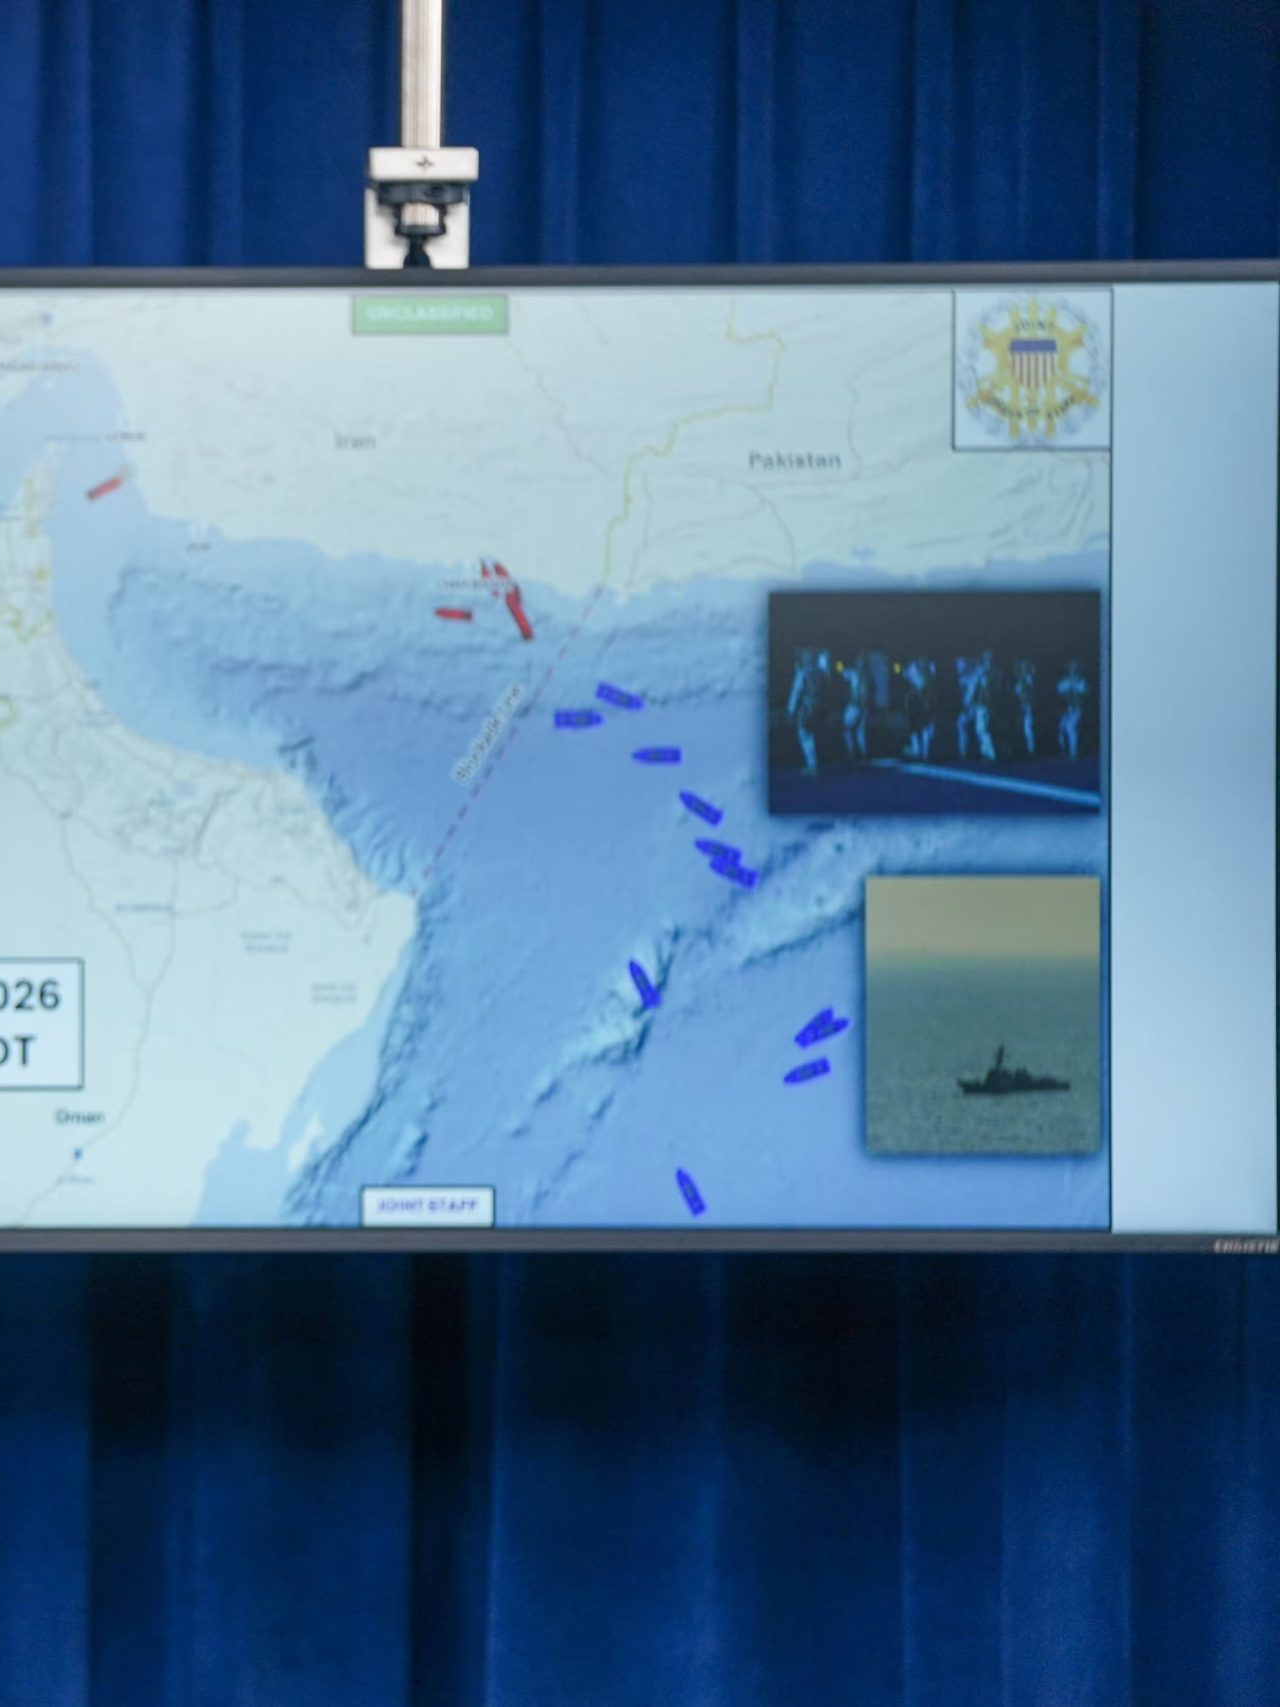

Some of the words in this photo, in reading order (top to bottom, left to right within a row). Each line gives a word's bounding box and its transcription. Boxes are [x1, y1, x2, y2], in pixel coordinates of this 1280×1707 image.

[335, 431, 376, 450] Iran
[748, 450, 842, 470] Pakistan
[55, 1107, 106, 1126] Oman
[428, 1198, 479, 1214] STAFF
